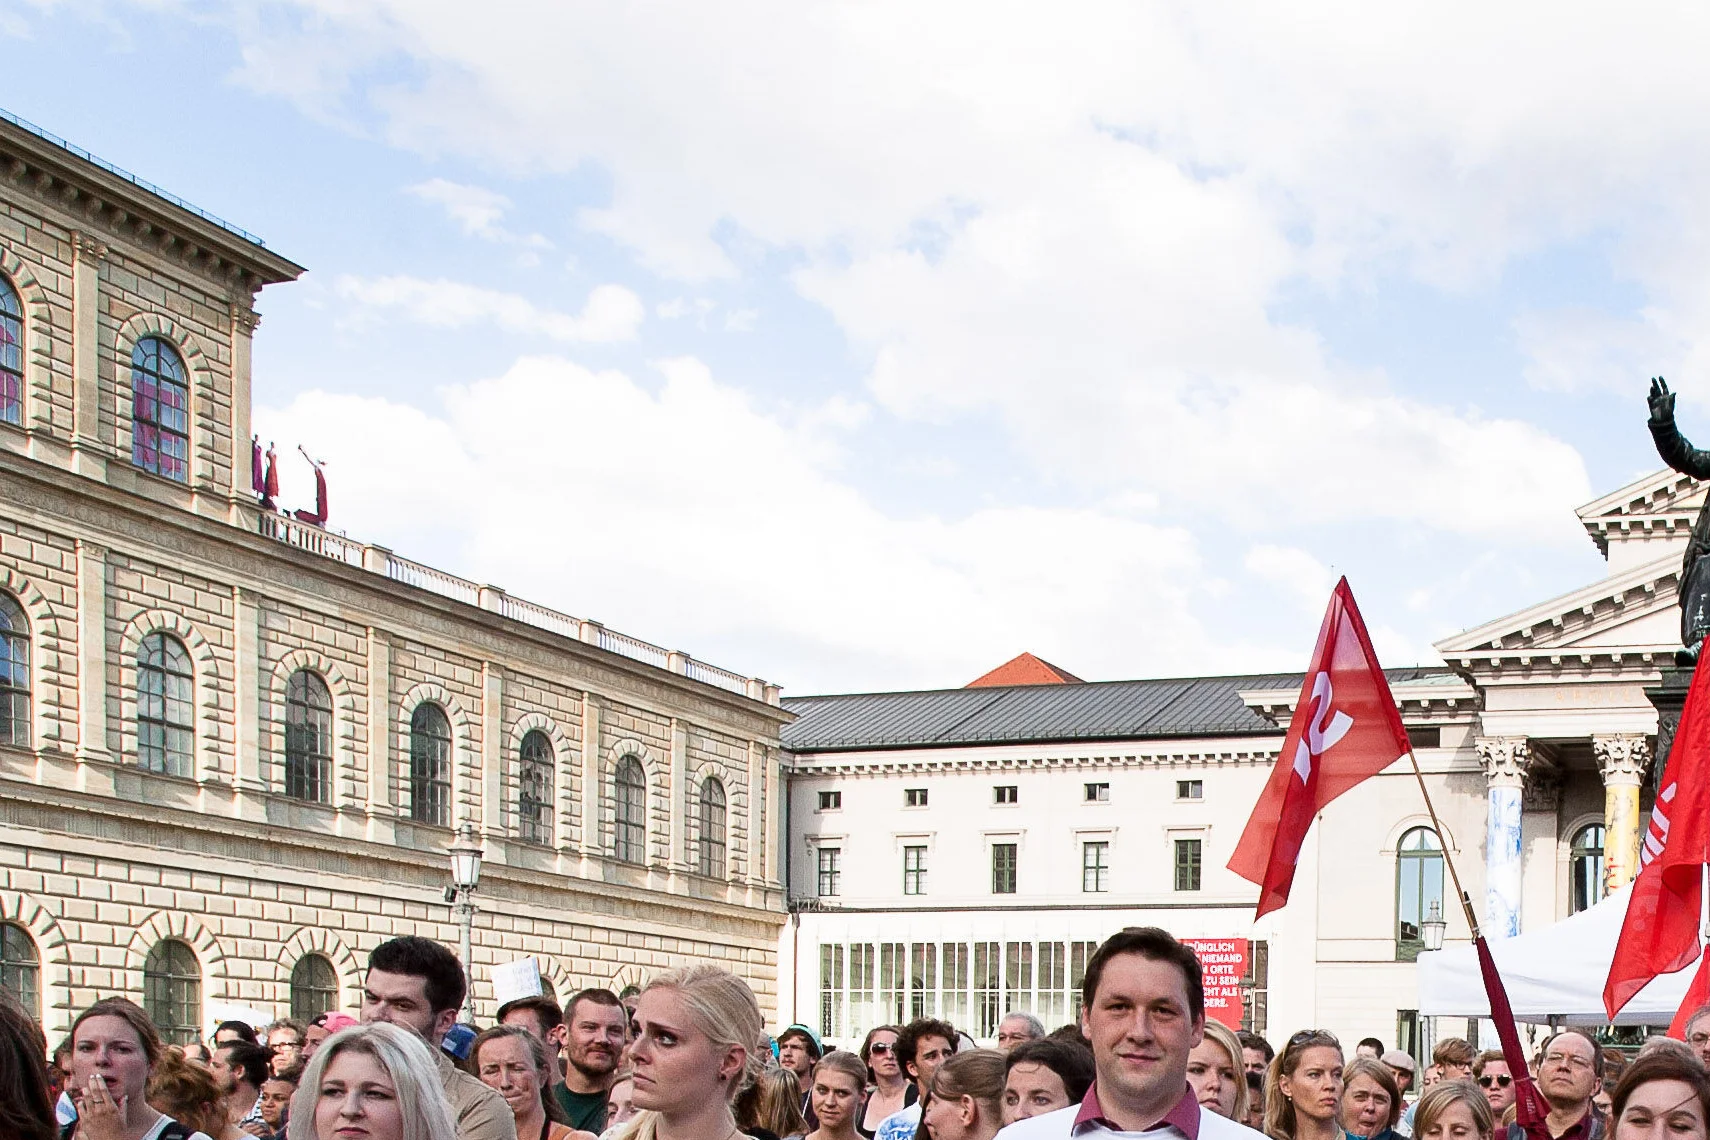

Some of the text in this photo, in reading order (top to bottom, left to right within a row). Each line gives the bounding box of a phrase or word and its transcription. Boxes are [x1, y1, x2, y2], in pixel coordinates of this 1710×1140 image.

[1201, 953, 1243, 964] NIEMAND
[1209, 965, 1234, 974] ORTE
[1205, 976, 1218, 985] ZU
[1220, 987, 1238, 996] ALS
